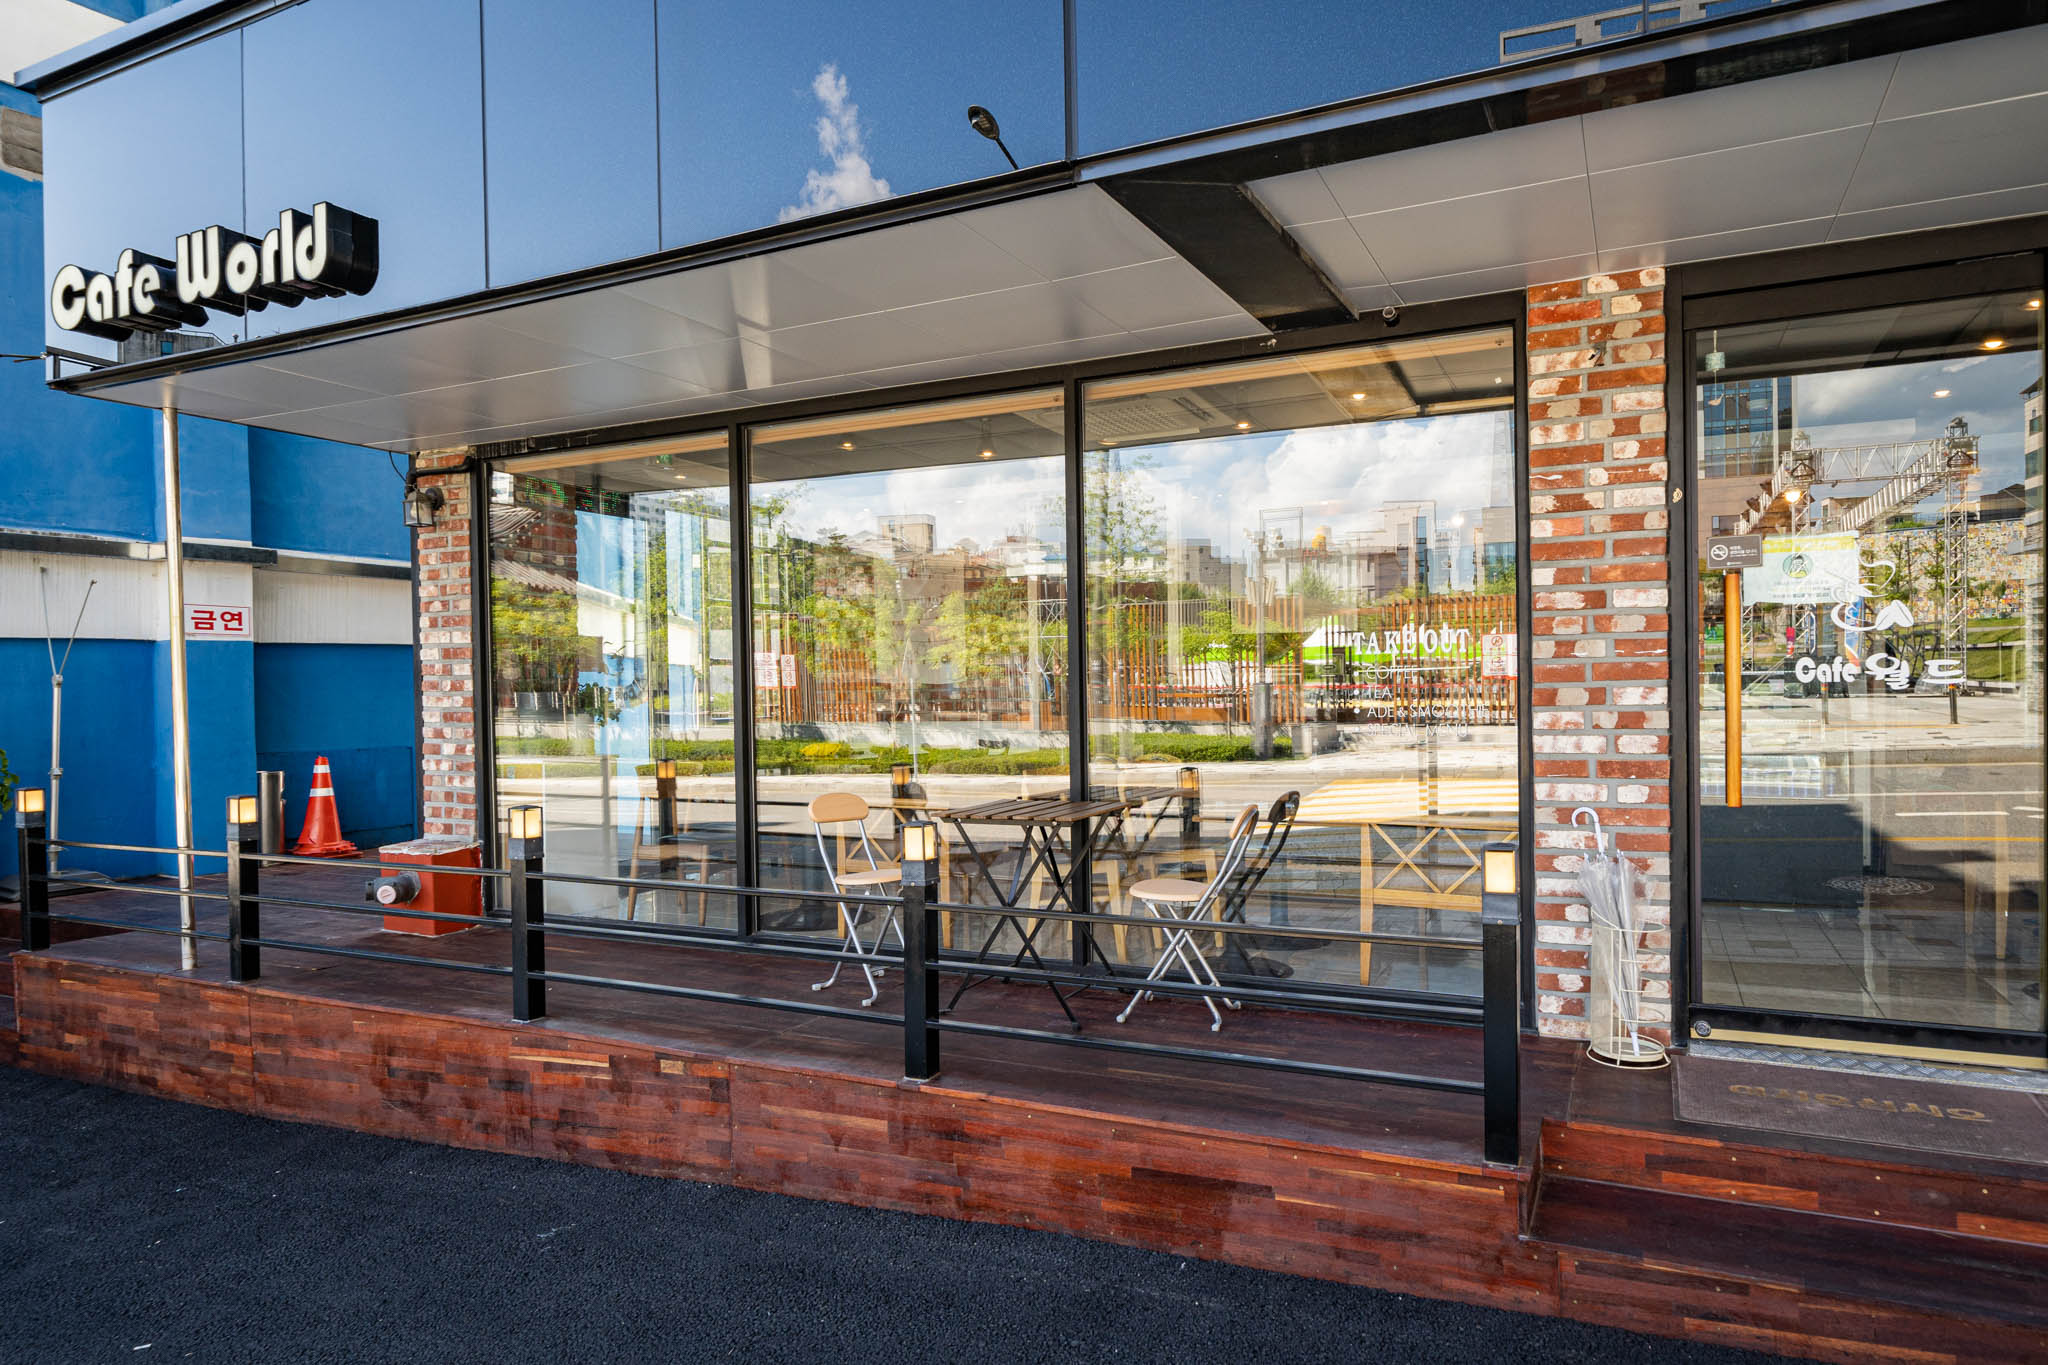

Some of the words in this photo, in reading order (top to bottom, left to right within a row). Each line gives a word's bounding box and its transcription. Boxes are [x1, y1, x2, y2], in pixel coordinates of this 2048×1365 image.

[51, 247, 162, 331] Cafe
[175, 200, 330, 304] World
[190, 609, 244, 632] 금연
[1351, 630, 1416, 656] TAKE
[1423, 628, 1470, 653] OUT
[1366, 665, 1419, 680] COFFEE
[1795, 655, 1862, 684] Cafe
[1864, 652, 1967, 690] 월드
[1367, 685, 1393, 699] TEA
[1367, 705, 1394, 718] ADE
[1398, 707, 1406, 718] &
[1409, 703, 1490, 718] SMOOTHIE
[1425, 722, 1468, 737] MENU
